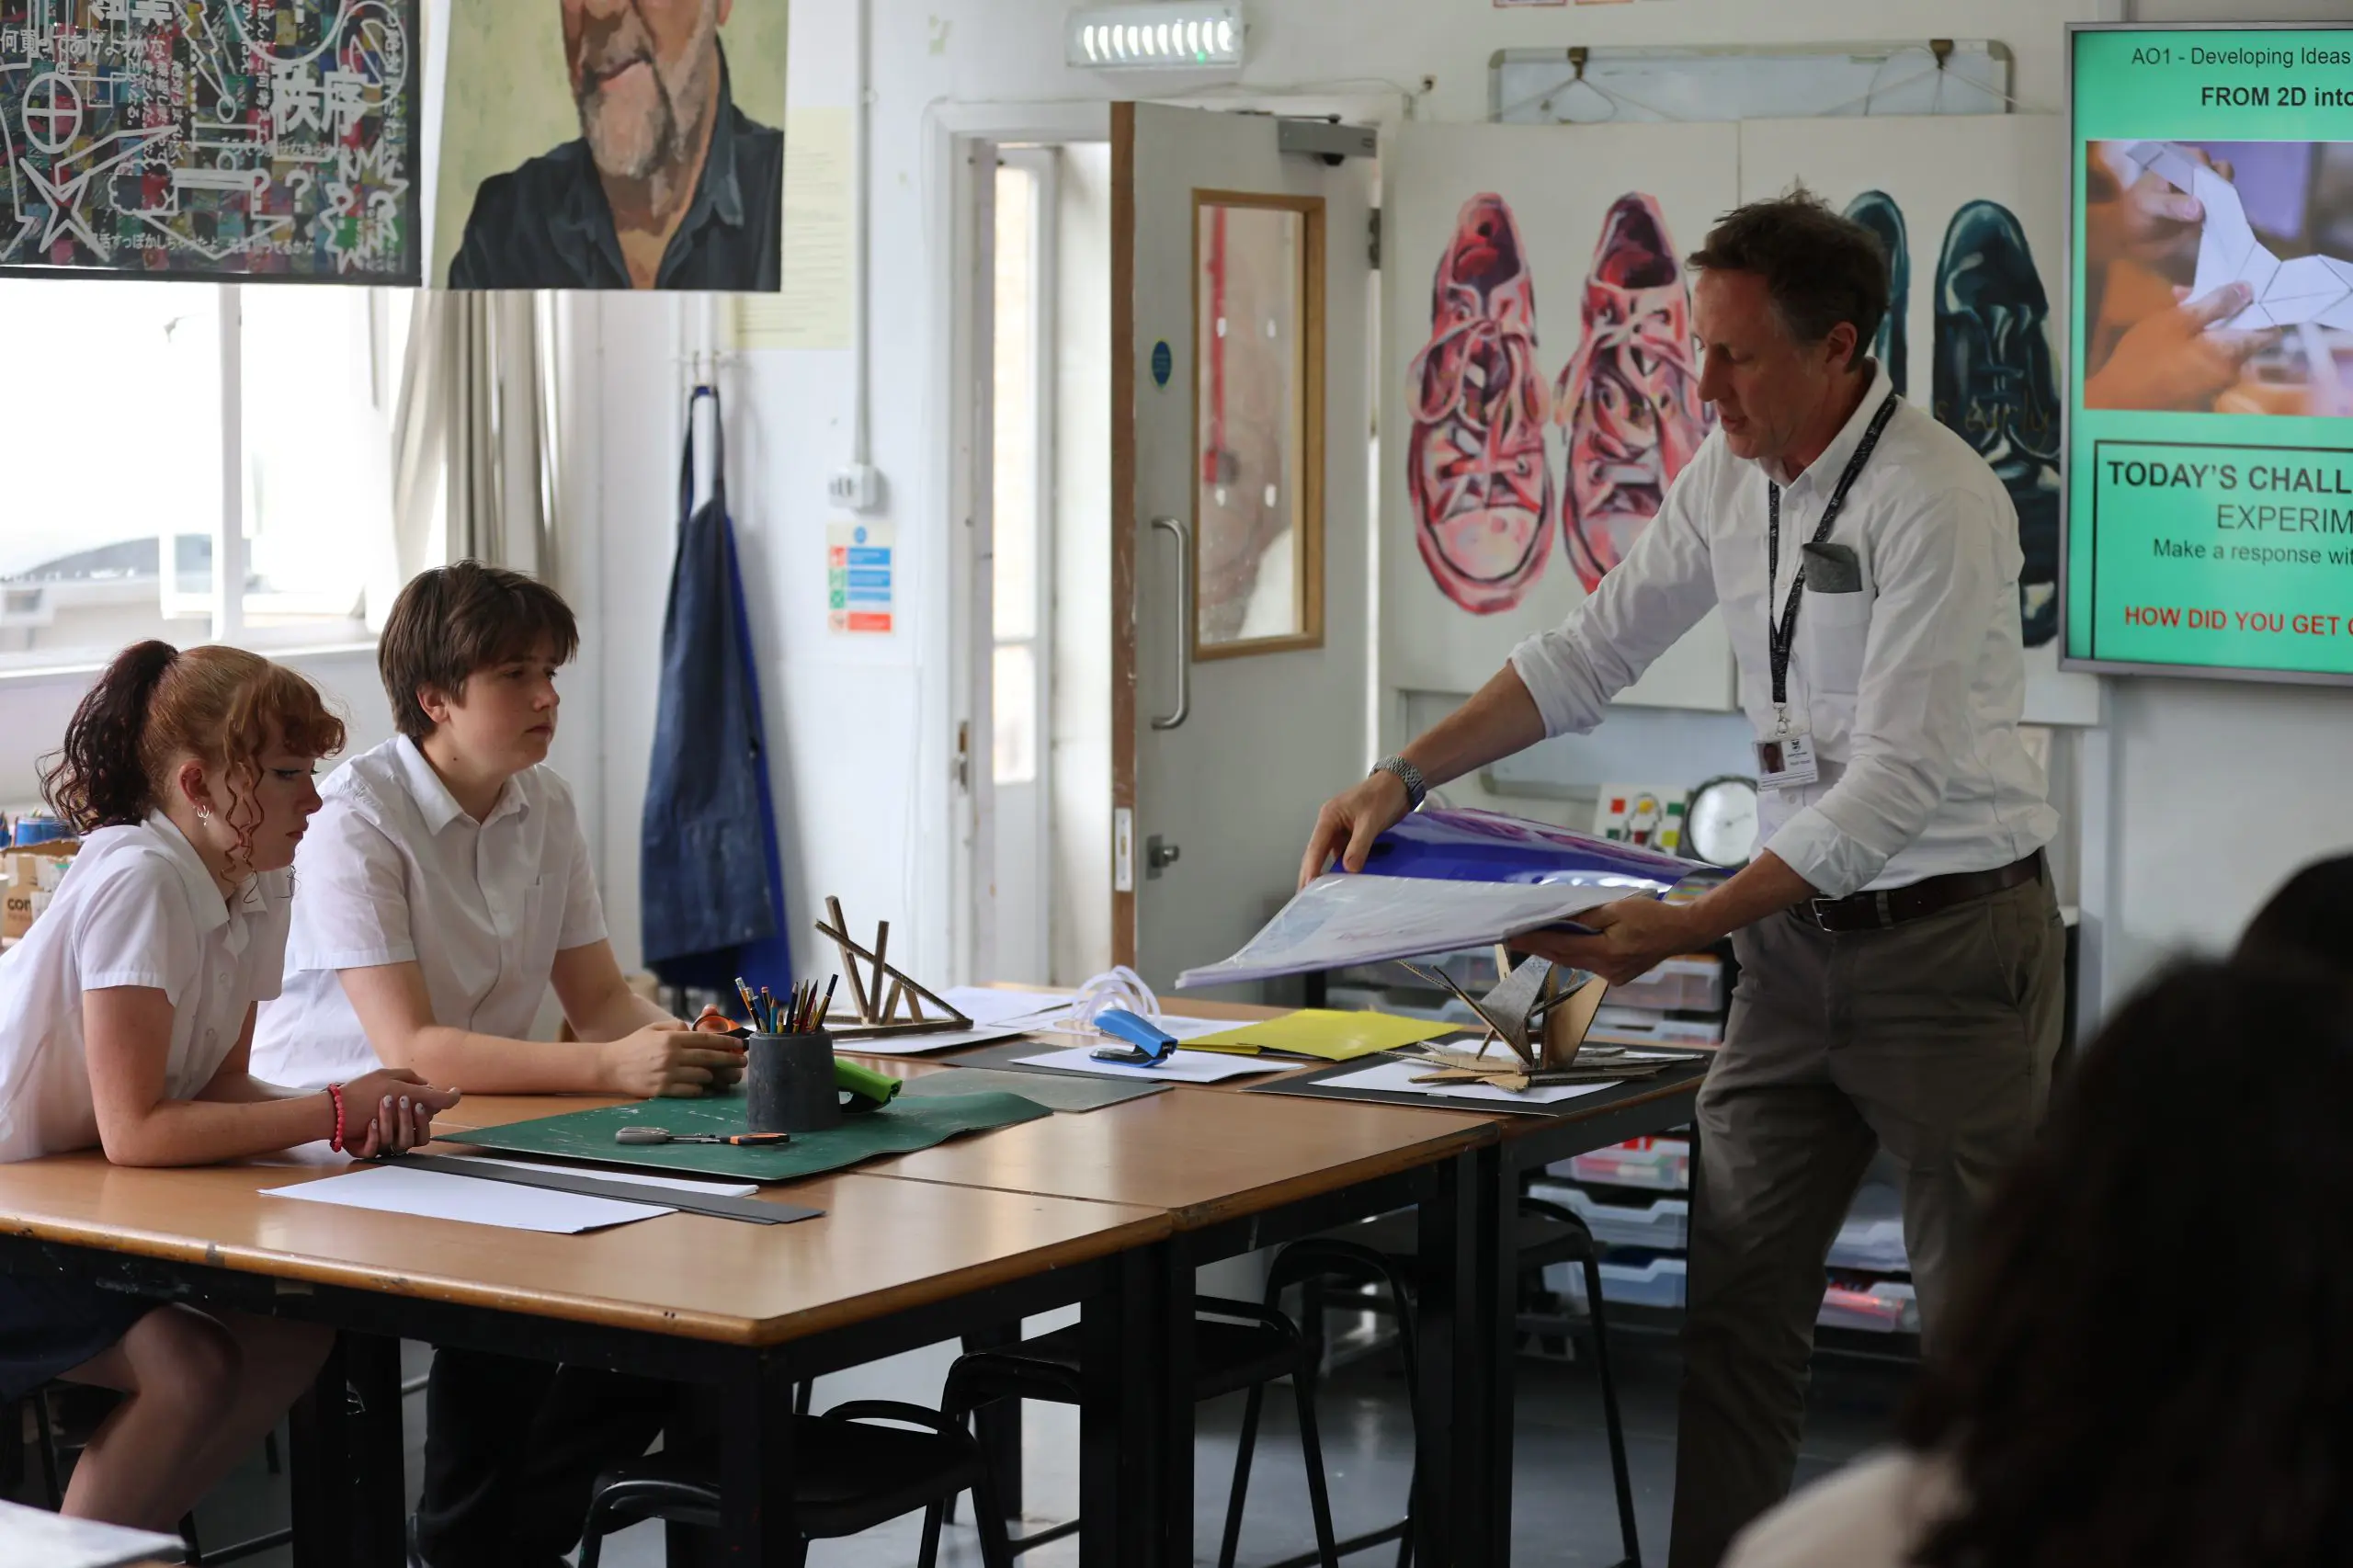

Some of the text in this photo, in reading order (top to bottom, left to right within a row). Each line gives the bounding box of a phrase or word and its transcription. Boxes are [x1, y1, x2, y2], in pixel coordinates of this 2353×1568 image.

[2131, 47, 2170, 65] AO1
[2191, 47, 2293, 68] Developing
[2302, 47, 2351, 65] Ideas
[270, 62, 369, 136] 秩序
[2201, 86, 2353, 107] FROM 2D into
[2107, 460, 2352, 494] TODAY'S CHALL
[2217, 505, 2353, 534] EXPERIM
[2154, 539, 2206, 559] Make
[2212, 546, 2225, 560] a
[2231, 545, 2321, 565] response
[2124, 606, 2181, 627] HOW
[2188, 608, 2226, 630] DID
[2234, 611, 2284, 632] YOU
[2291, 615, 2339, 636] GET
